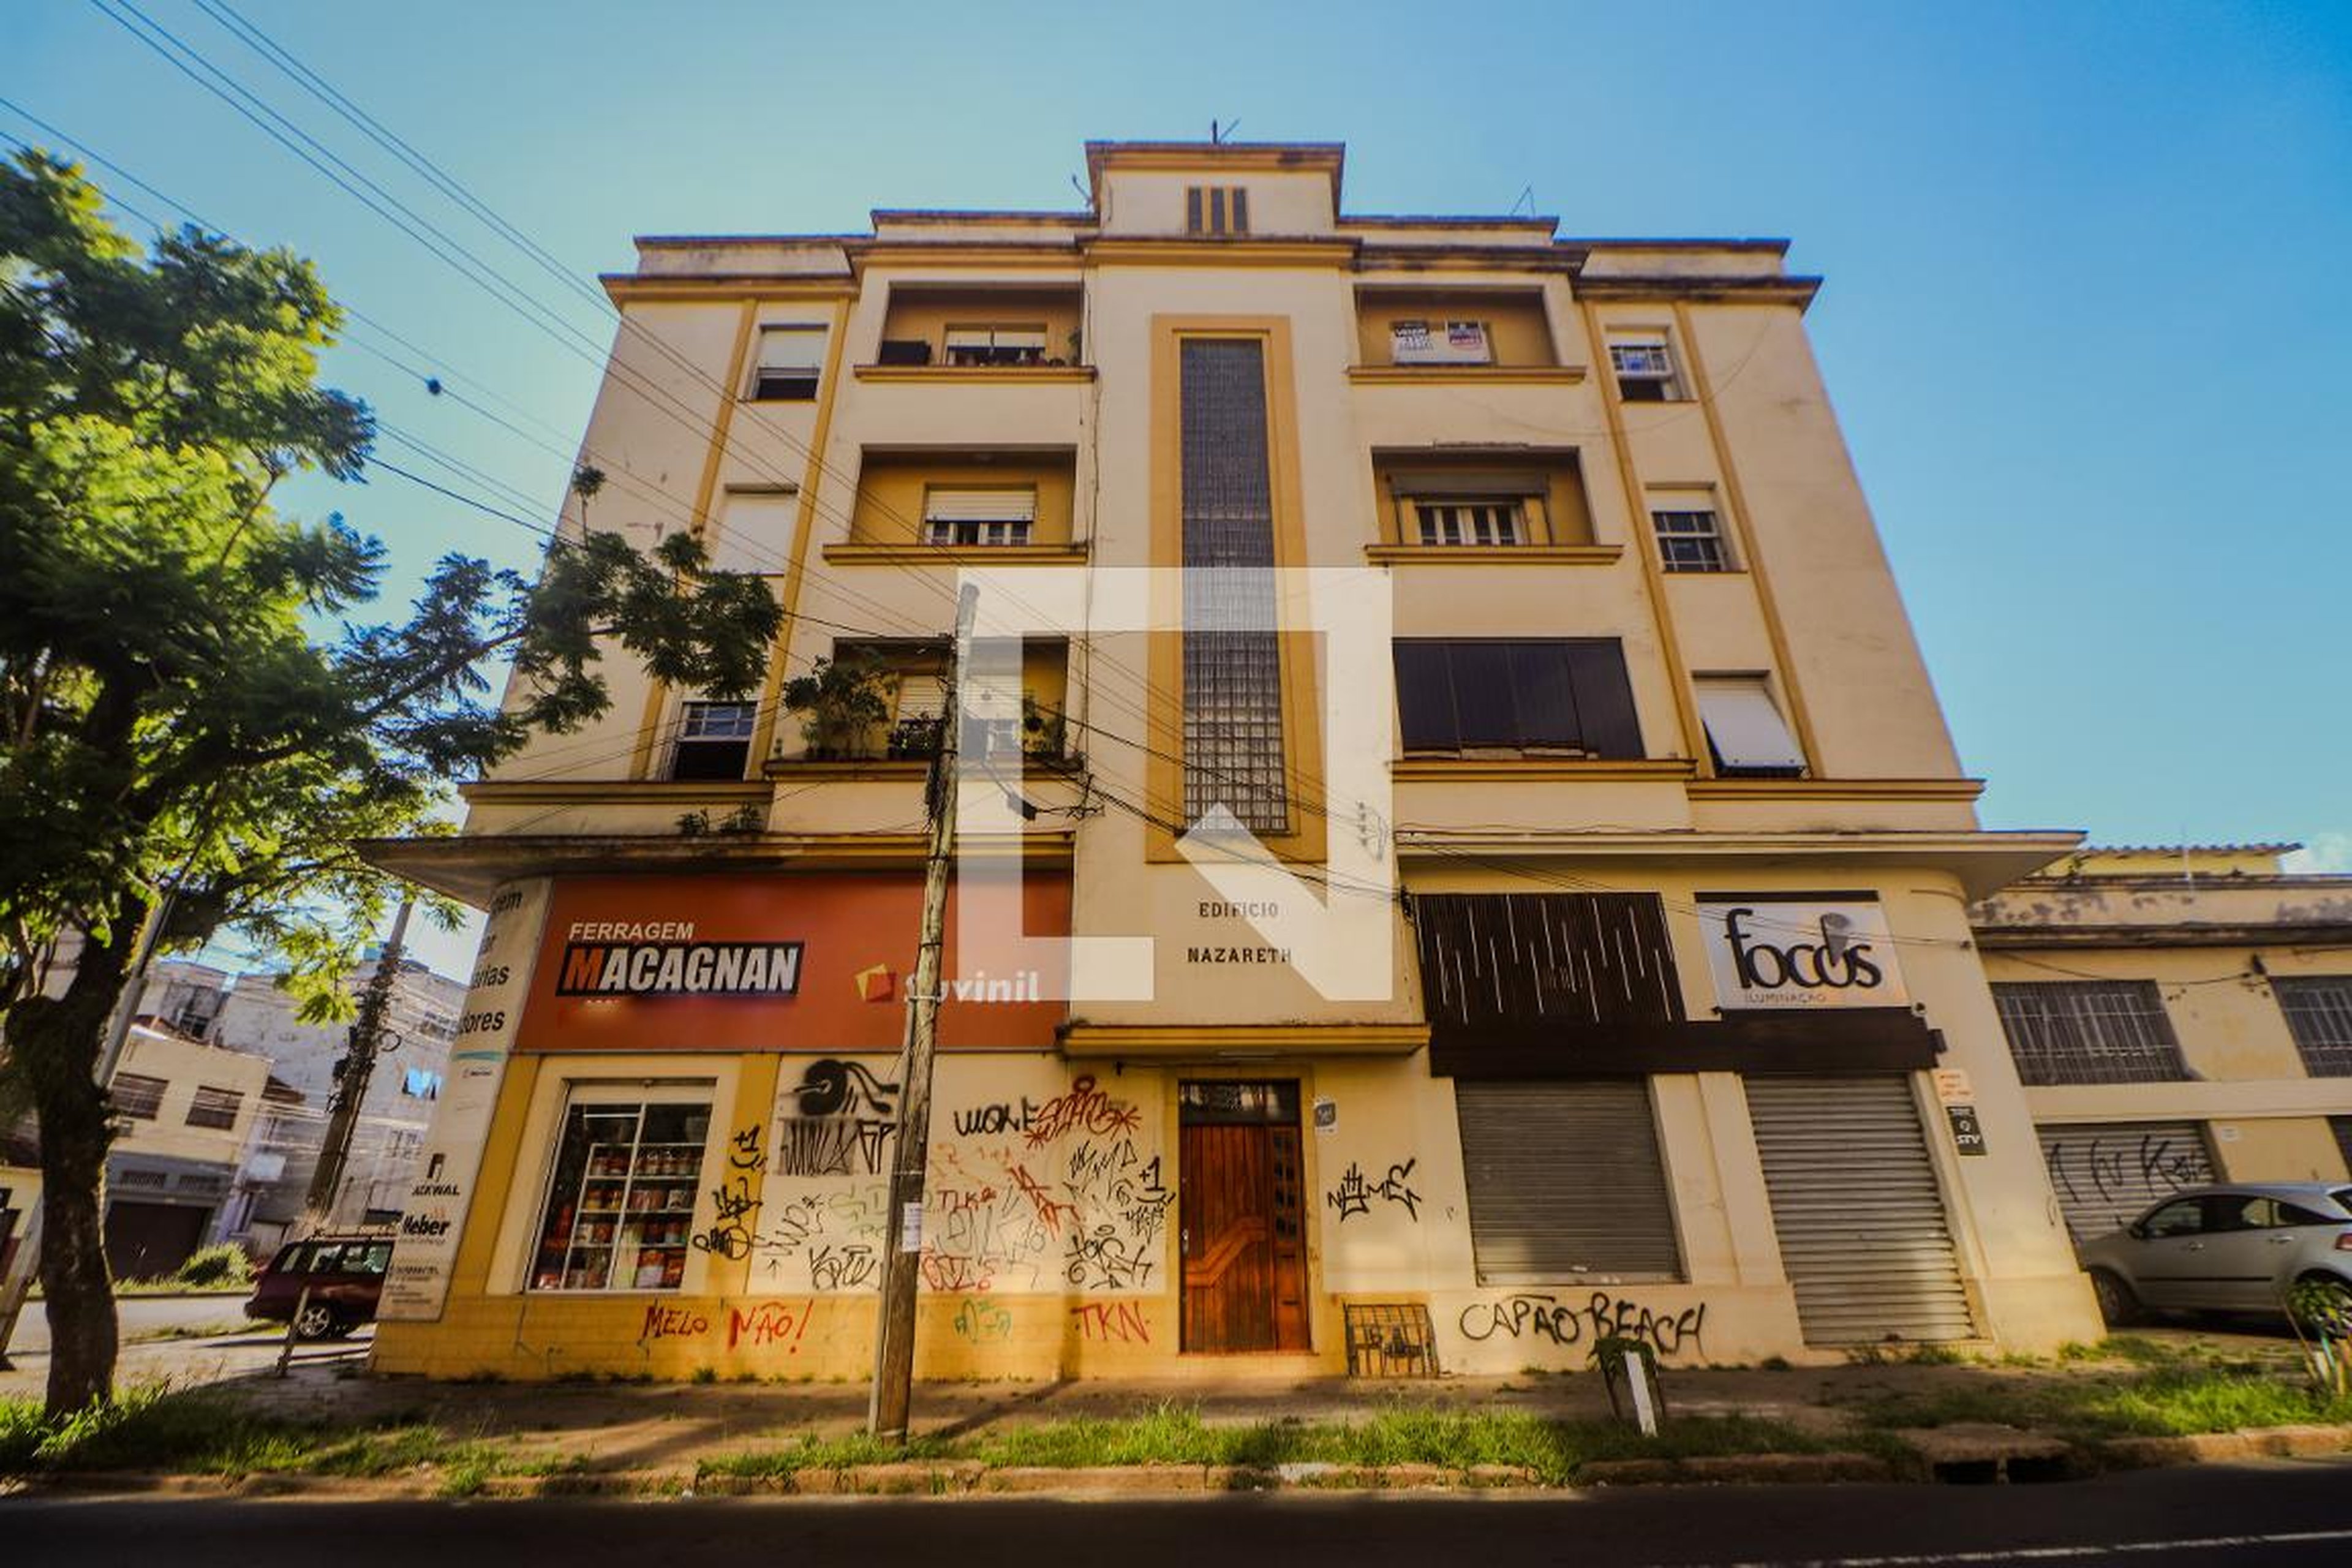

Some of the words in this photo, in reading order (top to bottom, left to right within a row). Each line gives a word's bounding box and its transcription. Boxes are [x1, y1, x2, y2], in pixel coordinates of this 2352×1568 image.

[1199, 902, 1279, 918] EDIFICIO
[569, 922, 695, 941] FERRAGEM
[1188, 948, 1292, 963] NAZARETH
[1724, 908, 1882, 989] focus
[564, 946, 799, 992] MACAGNAN
[1584, 1292, 1708, 1363] BEACH
